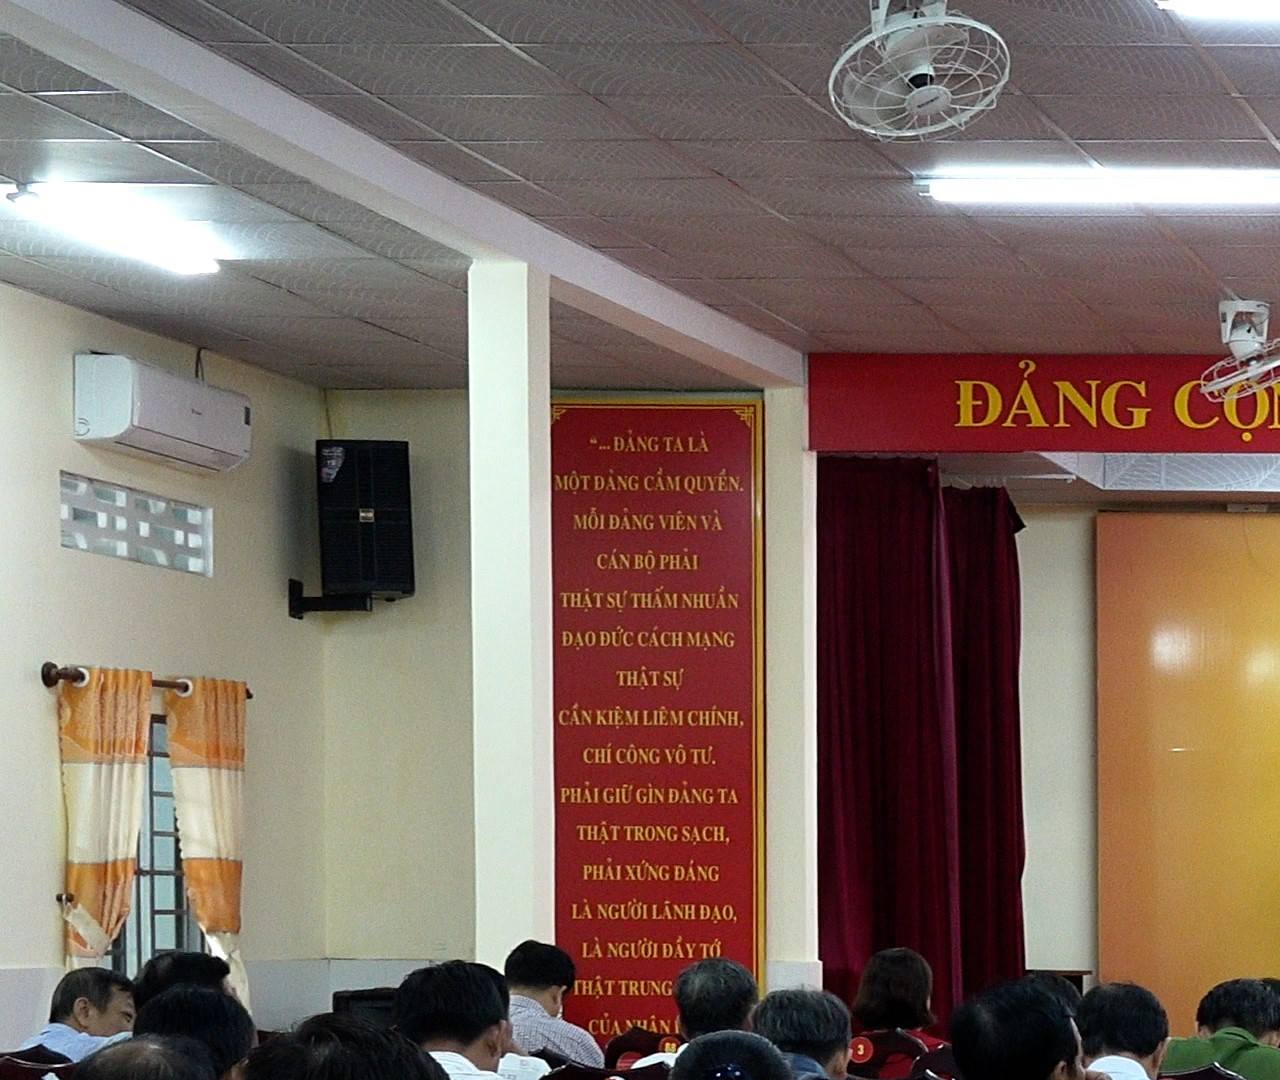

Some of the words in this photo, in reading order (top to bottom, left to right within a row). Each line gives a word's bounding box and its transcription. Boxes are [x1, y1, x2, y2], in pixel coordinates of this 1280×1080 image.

[954, 359, 1152, 429] ĐẢNG
[574, 507, 604, 530] MỖI
[609, 507, 654, 530] ĐẢNG
[659, 510, 697, 530] VIÊN
[701, 509, 722, 530] VÀ
[597, 550, 629, 569] CÁN
[635, 550, 655, 574] BỘ
[660, 548, 698, 570] PHẢI
[562, 631, 595, 650] ĐẠO
[600, 625, 633, 647] ĐỨC
[638, 626, 683, 648] CÁCH
[687, 632, 735, 650] MẠNG
[616, 666, 660, 690] THẬT
[664, 668, 683, 691] SỰ
[559, 704, 592, 726] CẦN
[597, 706, 638, 729] KIỆM
[643, 706, 686, 727] LIÊM
[690, 705, 744, 728] CHÍNH,
[561, 782, 598, 804] PHẢI
[602, 785, 632, 804] GIỮ
[636, 783, 664, 804] GÌN
[669, 781, 713, 804] ĐẢNG
[717, 788, 738, 804] TA
[577, 821, 620, 845] THẬT
[624, 825, 678, 842] TRONG
[681, 826, 729, 845] SẠCH,
[583, 858, 621, 881] PHẢI
[625, 860, 669, 881] XỨNG
[674, 860, 719, 881] ĐÁNG
[572, 903, 592, 920] LÀ
[597, 901, 648, 920] NGƯỜI
[652, 901, 696, 920] LÃNH
[700, 904, 736, 924] ĐẠO,
[574, 976, 615, 999] THẬT
[618, 980, 672, 996] TRUNG
[857, 1044, 865, 1055] 3
